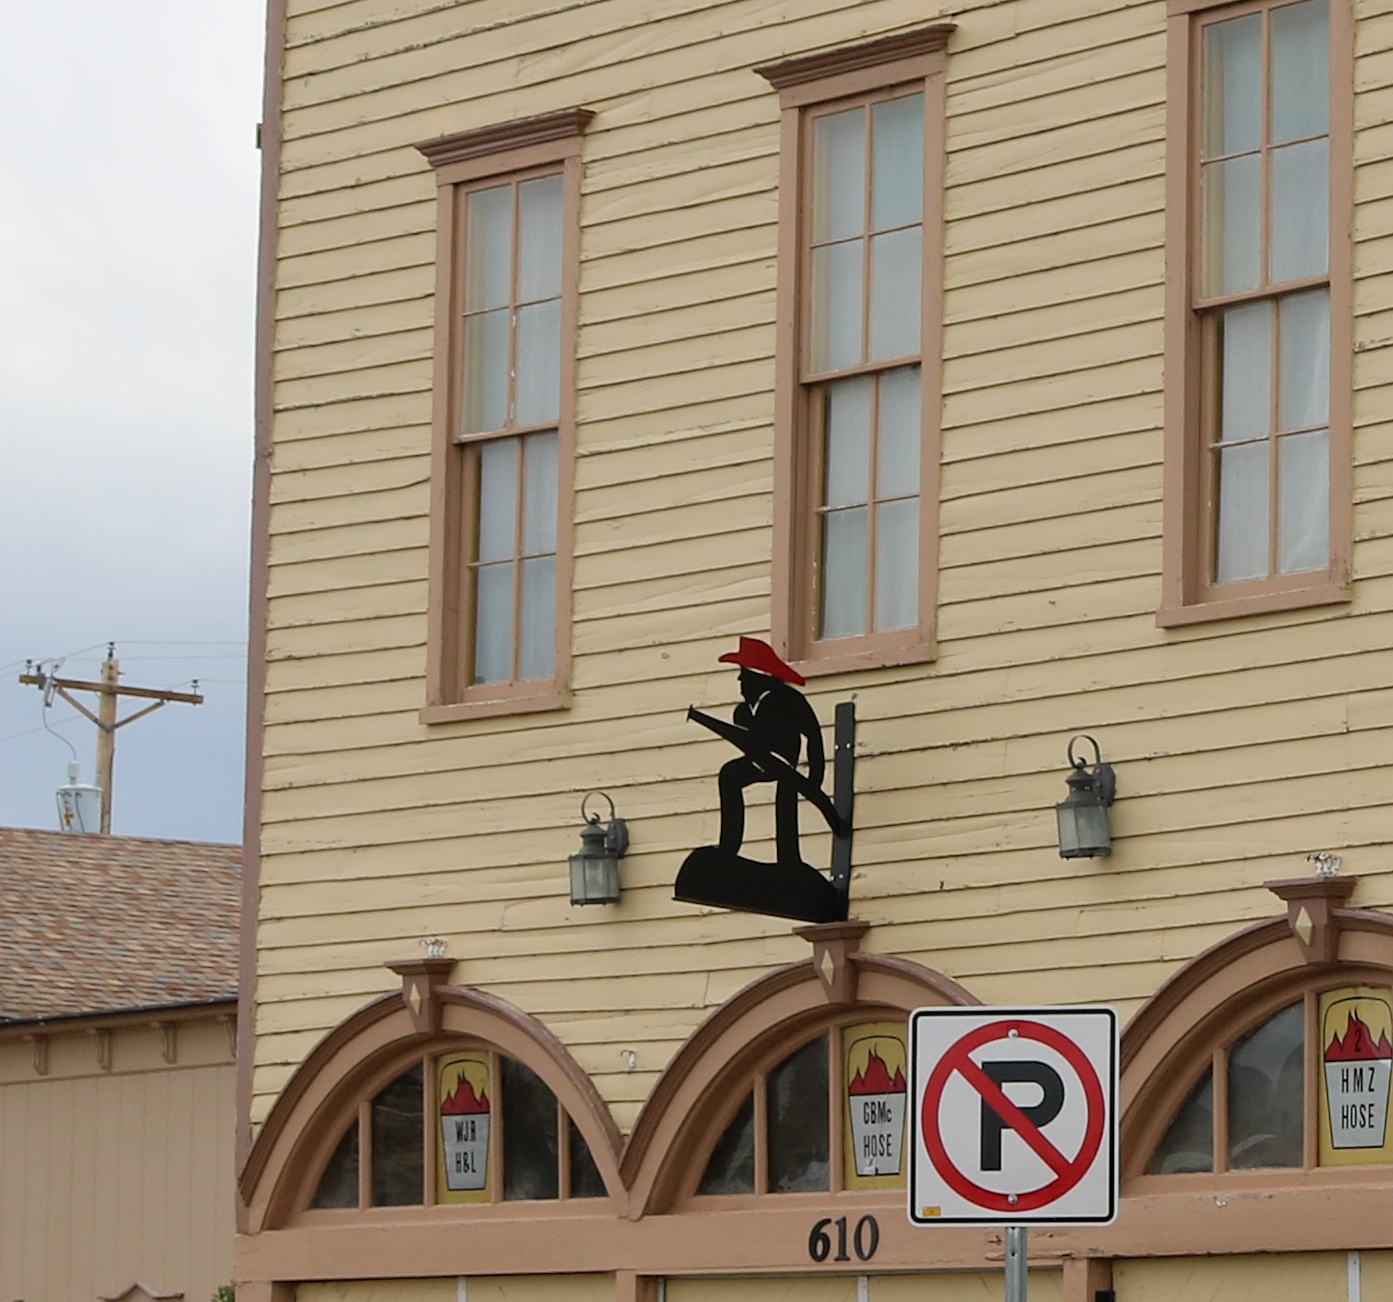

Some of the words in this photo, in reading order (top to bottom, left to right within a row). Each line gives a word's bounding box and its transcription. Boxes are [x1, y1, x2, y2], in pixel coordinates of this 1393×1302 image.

[1341, 1103, 1375, 1129] HOSE
[863, 1133, 893, 1158] HOSE
[455, 1150, 477, 1174] H&L
[808, 1213, 880, 1263] 610
